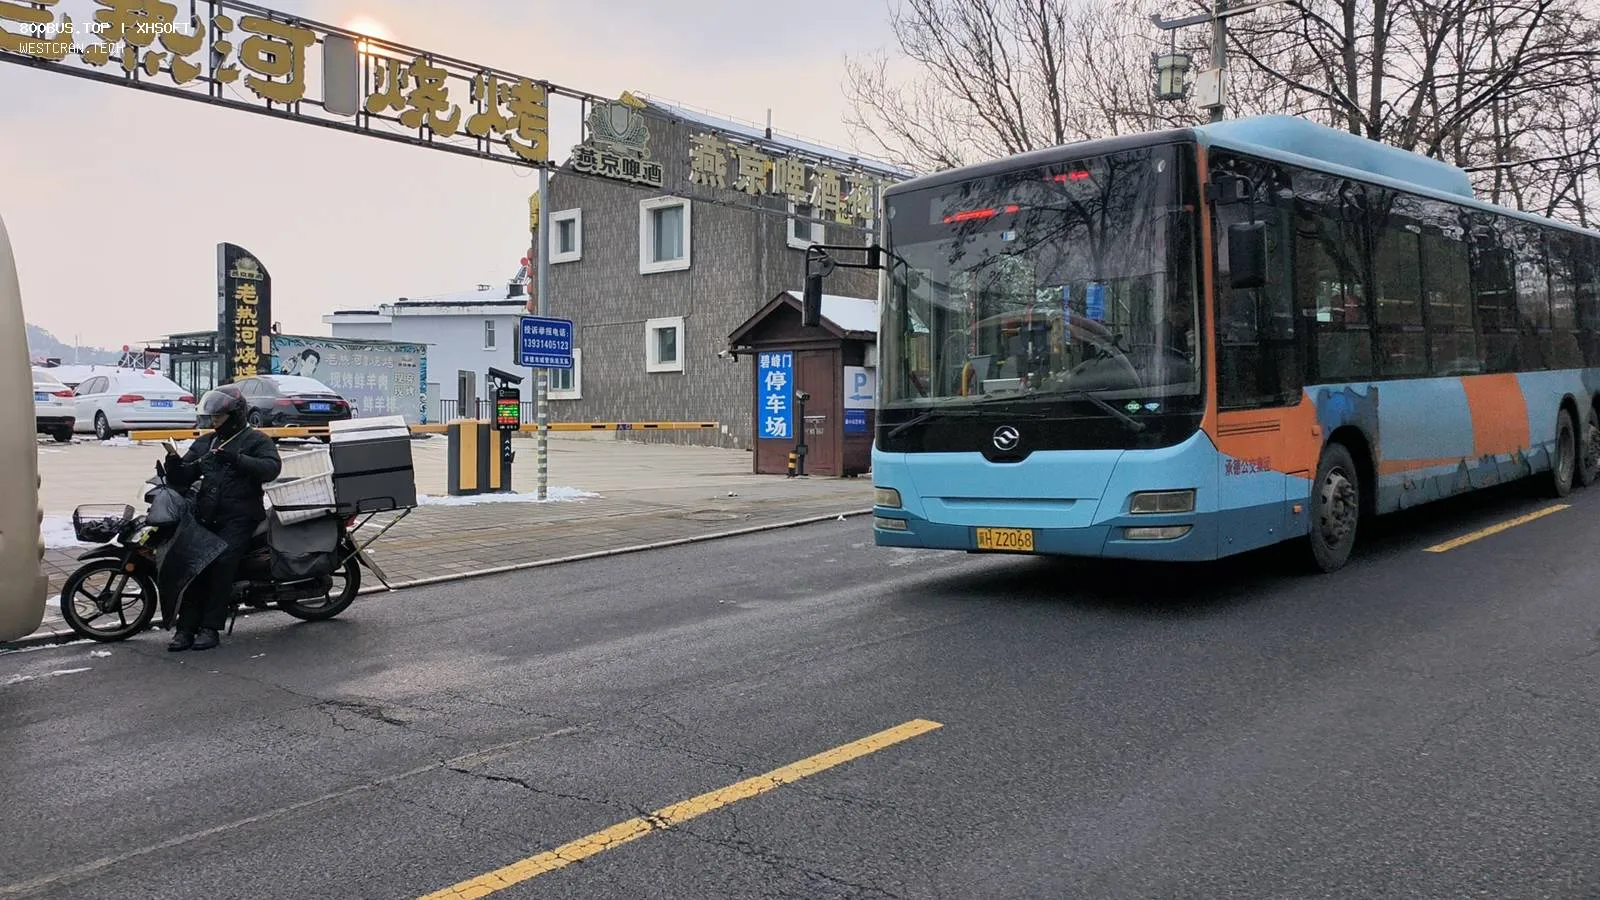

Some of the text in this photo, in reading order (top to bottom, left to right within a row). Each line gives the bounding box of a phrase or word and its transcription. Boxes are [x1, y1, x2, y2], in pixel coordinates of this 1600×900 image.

[364, 55, 549, 164] 烧烤
[572, 145, 663, 187] 燕京啤酒
[523, 338, 569, 350] 13931405123
[760, 354, 792, 369] 碧峰门
[854, 373, 867, 393] P
[764, 371, 787, 437] 停车场
